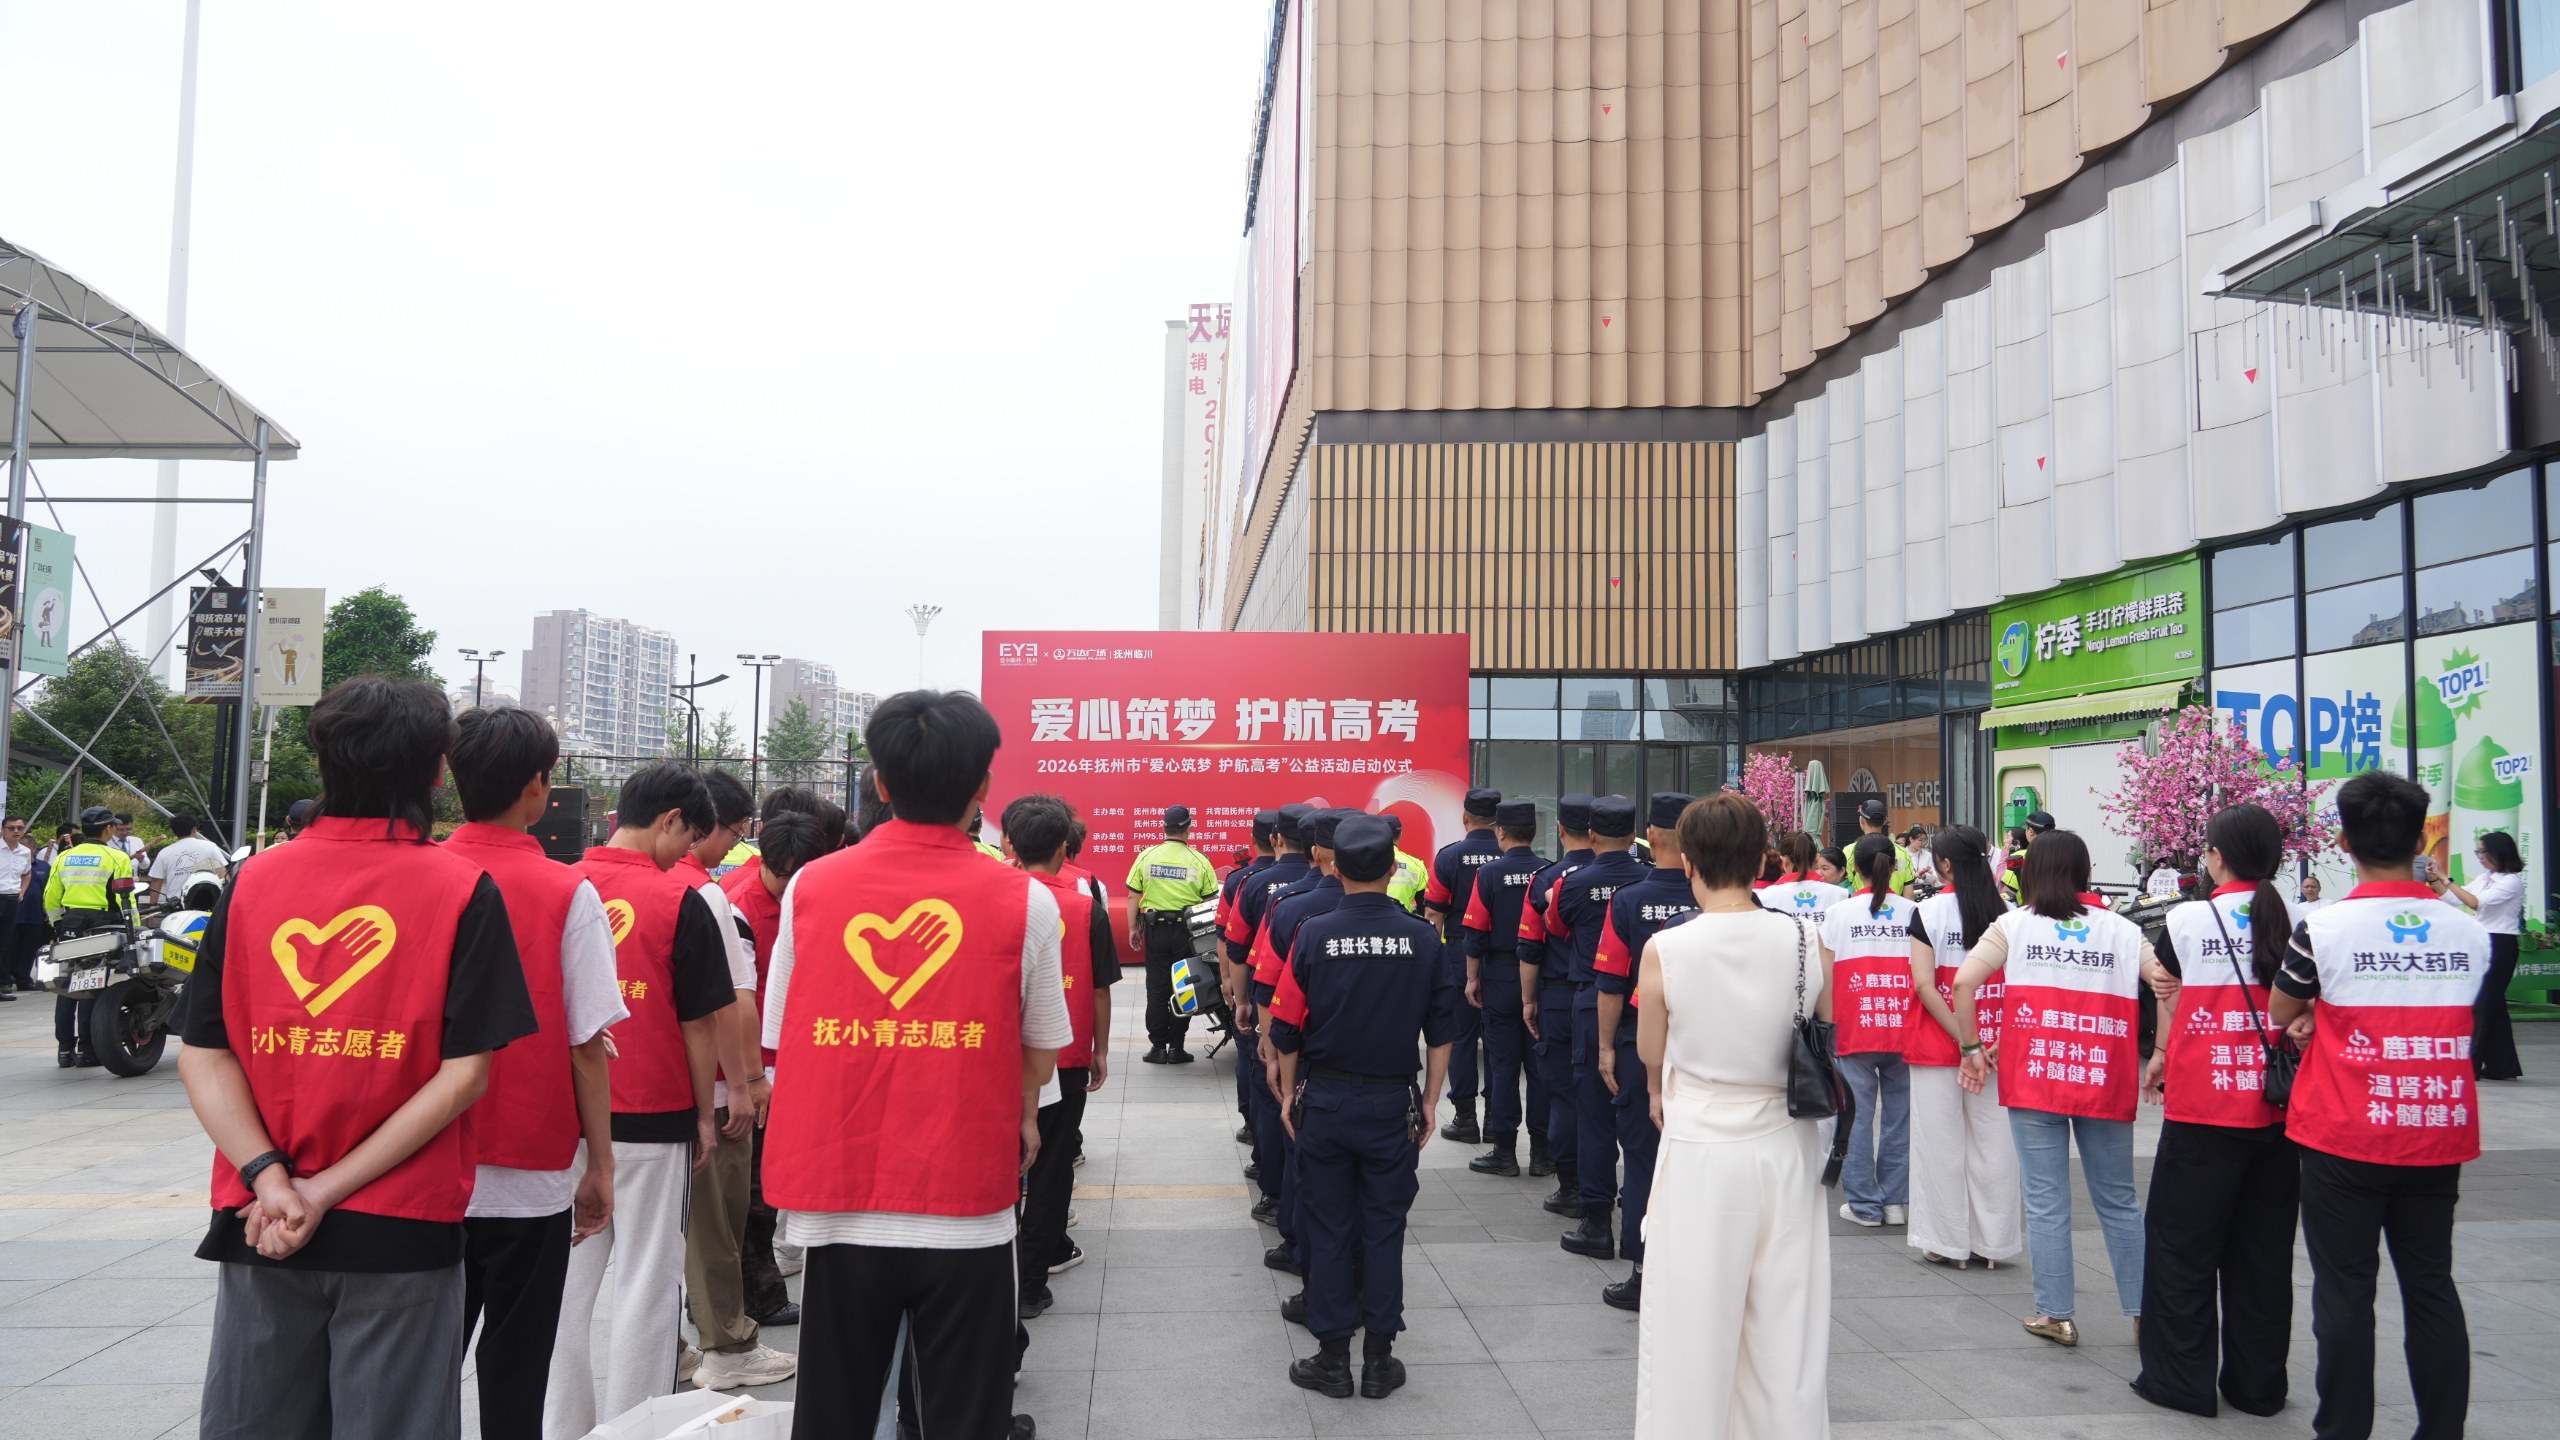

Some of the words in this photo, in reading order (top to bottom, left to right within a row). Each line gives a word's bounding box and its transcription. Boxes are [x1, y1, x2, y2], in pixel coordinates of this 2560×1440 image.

[2086, 592, 2184, 632] 手打柠檬鲜果茶
[2035, 615, 2081, 661] 柠季
[2106, 634, 2129, 648] Lemon
[2129, 629, 2150, 643] Fresh
[2151, 626, 2168, 640] Fruit
[2169, 623, 2184, 635] Tea
[1113, 649, 1153, 659] 抚州临川
[1031, 698, 1216, 741] 爱心筑梦
[1236, 698, 1419, 742] 护航高考
[1037, 758, 1212, 773] 2026年抚州市“爱心筑梦
[1219, 757, 1413, 774] 护航高考”公益活动启动仪式
[1887, 784, 1912, 807] THE
[1093, 808, 1125, 816] 主办单位
[1093, 832, 1125, 841] 承办单位
[1093, 845, 1125, 853] 支持单位
[1503, 873, 1534, 886] 老班长
[1589, 886, 1620, 901] 老班
[1326, 936, 1413, 956] 老班长警务队
[2026, 945, 2114, 969] 洪兴大药房
[2353, 952, 2470, 972] 洪兴大药房
[812, 1017, 987, 1049] 抚小青志愿者
[2041, 1008, 2128, 1038] 鹿茸口服液
[251, 1025, 407, 1060] 小青志愿者
[2029, 1038, 2108, 1064] 温肾补血
[2027, 1060, 2107, 1086] 补髓健骨
